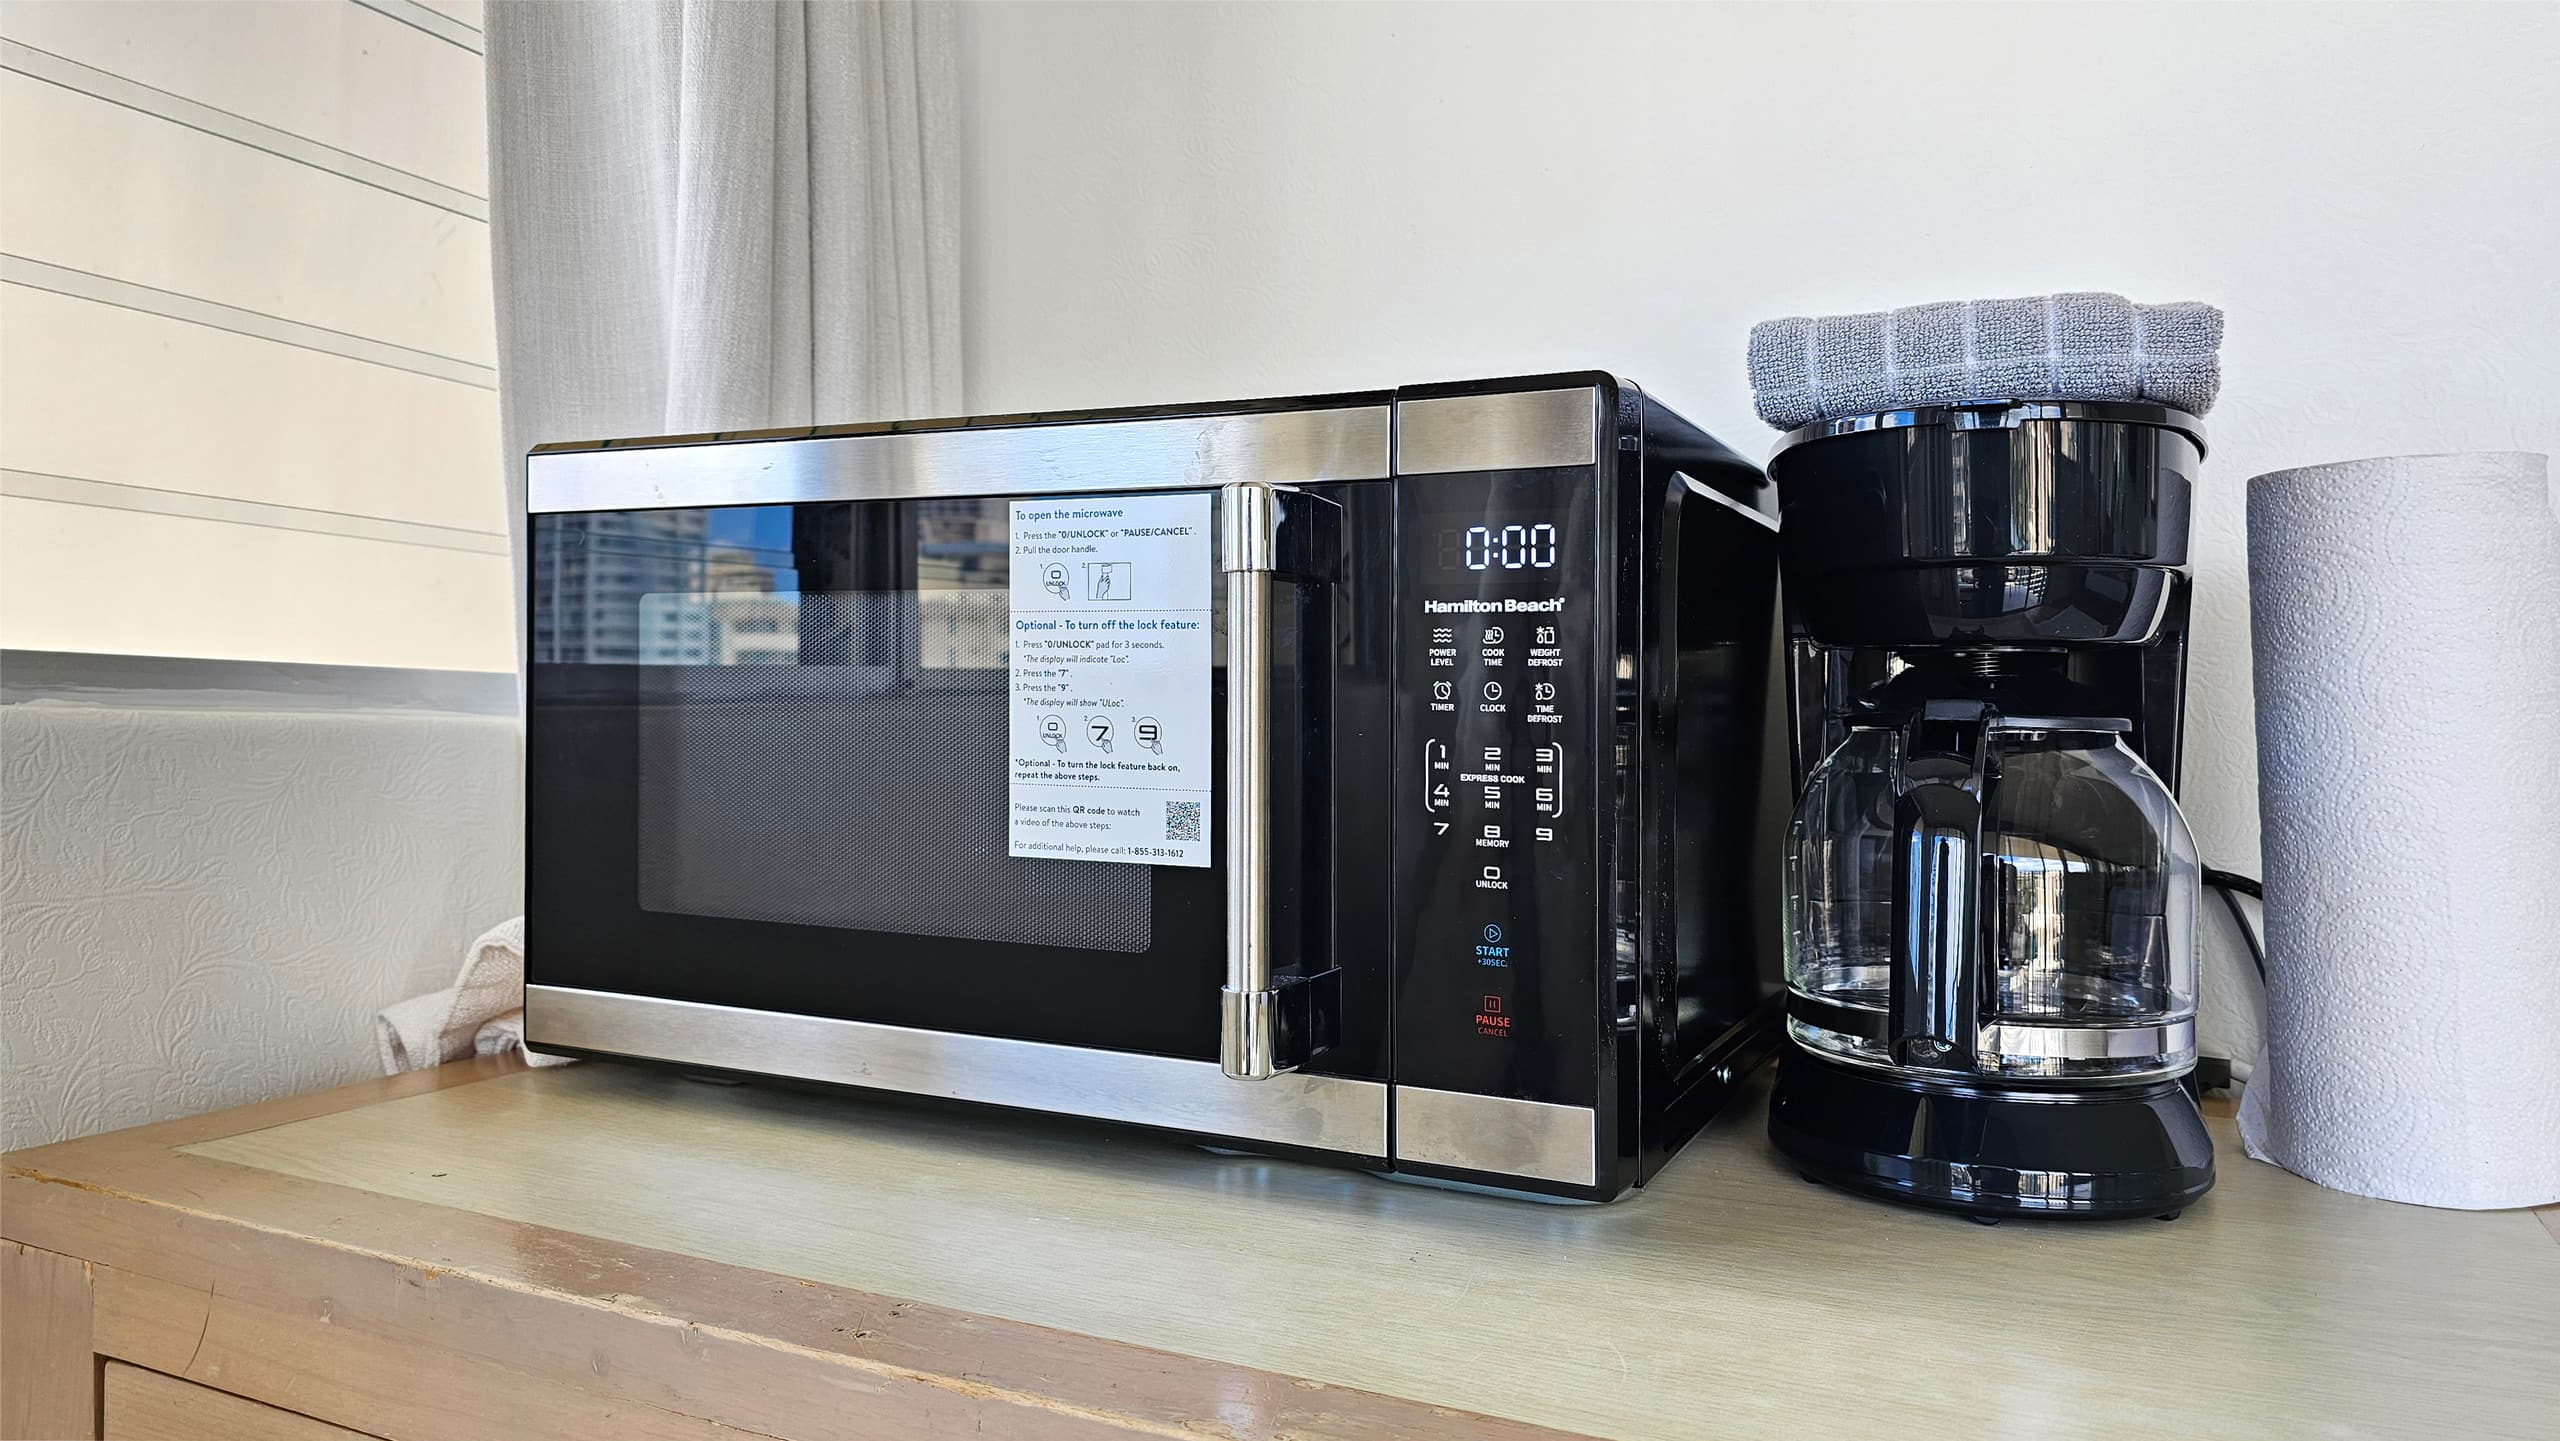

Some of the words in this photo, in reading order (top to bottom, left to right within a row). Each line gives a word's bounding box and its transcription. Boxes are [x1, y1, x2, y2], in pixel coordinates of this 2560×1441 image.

[1016, 511, 1026, 520] To
[1029, 512, 1050, 522] open
[1055, 510, 1069, 519] the
[1073, 509, 1123, 518] microwave
[1023, 531, 1042, 539] Press
[1044, 531, 1057, 539] the
[1023, 546, 1036, 554] Pull
[1038, 546, 1050, 554] the
[1052, 545, 1069, 553] door
[1071, 545, 1098, 553] handle.
[1465, 524, 1556, 570] 0:00
[1424, 599, 1502, 614] Hamilton
[1016, 620, 1057, 632] Optional
[1065, 620, 1076, 629] To
[1079, 621, 1099, 629] turn
[1101, 620, 1117, 629] off
[1119, 620, 1135, 629] the
[1137, 620, 1158, 629] lock
[1161, 620, 1200, 630] feature:
[1023, 641, 1043, 649] Press
[1045, 640, 1094, 648] "0/UNLOCK"
[1096, 641, 1110, 650] pad
[1112, 640, 1123, 648] for
[1131, 641, 1164, 649] seconds.
[1429, 649, 1456, 657] POWER
[1482, 649, 1505, 657] COOK
[1530, 649, 1561, 657] WEIGHT
[1040, 655, 1064, 665] display
[1066, 655, 1078, 663] will
[1431, 658, 1454, 666] LEVEL
[1484, 658, 1503, 666] TIME
[1528, 658, 1563, 666] DEFROST
[1044, 669, 1057, 677] the
[1015, 683, 1021, 691] 3.
[1044, 683, 1056, 691] the
[1040, 698, 1064, 709] display
[1066, 698, 1078, 706] will
[1079, 699, 1098, 707] show
[1431, 703, 1454, 711] TIMER
[1480, 704, 1506, 712] CLOCK
[1536, 705, 1554, 713] TIME
[1528, 715, 1563, 723] DEFROST
[1091, 726, 1109, 741] 7
[1139, 725, 1158, 740] 9
[1440, 745, 1445, 758] 1
[1484, 747, 1501, 760] 2
[1536, 749, 1553, 762] 3
[1057, 760, 1066, 768] To
[1085, 761, 1098, 769] the
[1100, 761, 1116, 769] lock
[1118, 762, 1146, 770] feature
[1147, 763, 1166, 771] back
[1168, 764, 1181, 773] on,
[1434, 762, 1449, 770] MIN
[1015, 772, 1039, 781] repeat
[1055, 772, 1076, 780] above
[1078, 774, 1100, 782] steps.
[1460, 774, 1498, 782] EXPRESS
[1500, 775, 1525, 783] COOK
[1433, 784, 1450, 797] 4
[1484, 786, 1500, 799] 5
[1536, 788, 1553, 801] 6
[1434, 799, 1449, 807] MIN
[1015, 803, 1037, 812] Please
[1039, 805, 1056, 813] scan
[1057, 805, 1071, 813] this
[1073, 806, 1085, 814] QR
[1087, 806, 1105, 814] code
[1107, 807, 1116, 815] to
[1117, 808, 1140, 816] watch
[1042, 819, 1050, 827] of
[1065, 820, 1088, 828] above
[1090, 822, 1112, 831] steps:
[1433, 822, 1449, 835] 7
[1484, 825, 1500, 838] 8
[1536, 828, 1553, 841] 9
[1476, 839, 1509, 848] MEMORY
[1015, 841, 1027, 849] For
[1029, 842, 1063, 850] additional
[1066, 843, 1084, 853] help,
[1085, 845, 1109, 854] please
[1111, 847, 1126, 855] call:
[1128, 847, 1184, 858] 1-855-313-1612
[1483, 866, 1500, 879] 0
[1476, 880, 1508, 889] UNLOCK
[1476, 945, 1509, 957] START
[1476, 1015, 1511, 1027] PAUSE
[1478, 1027, 1508, 1037] CANCEL
